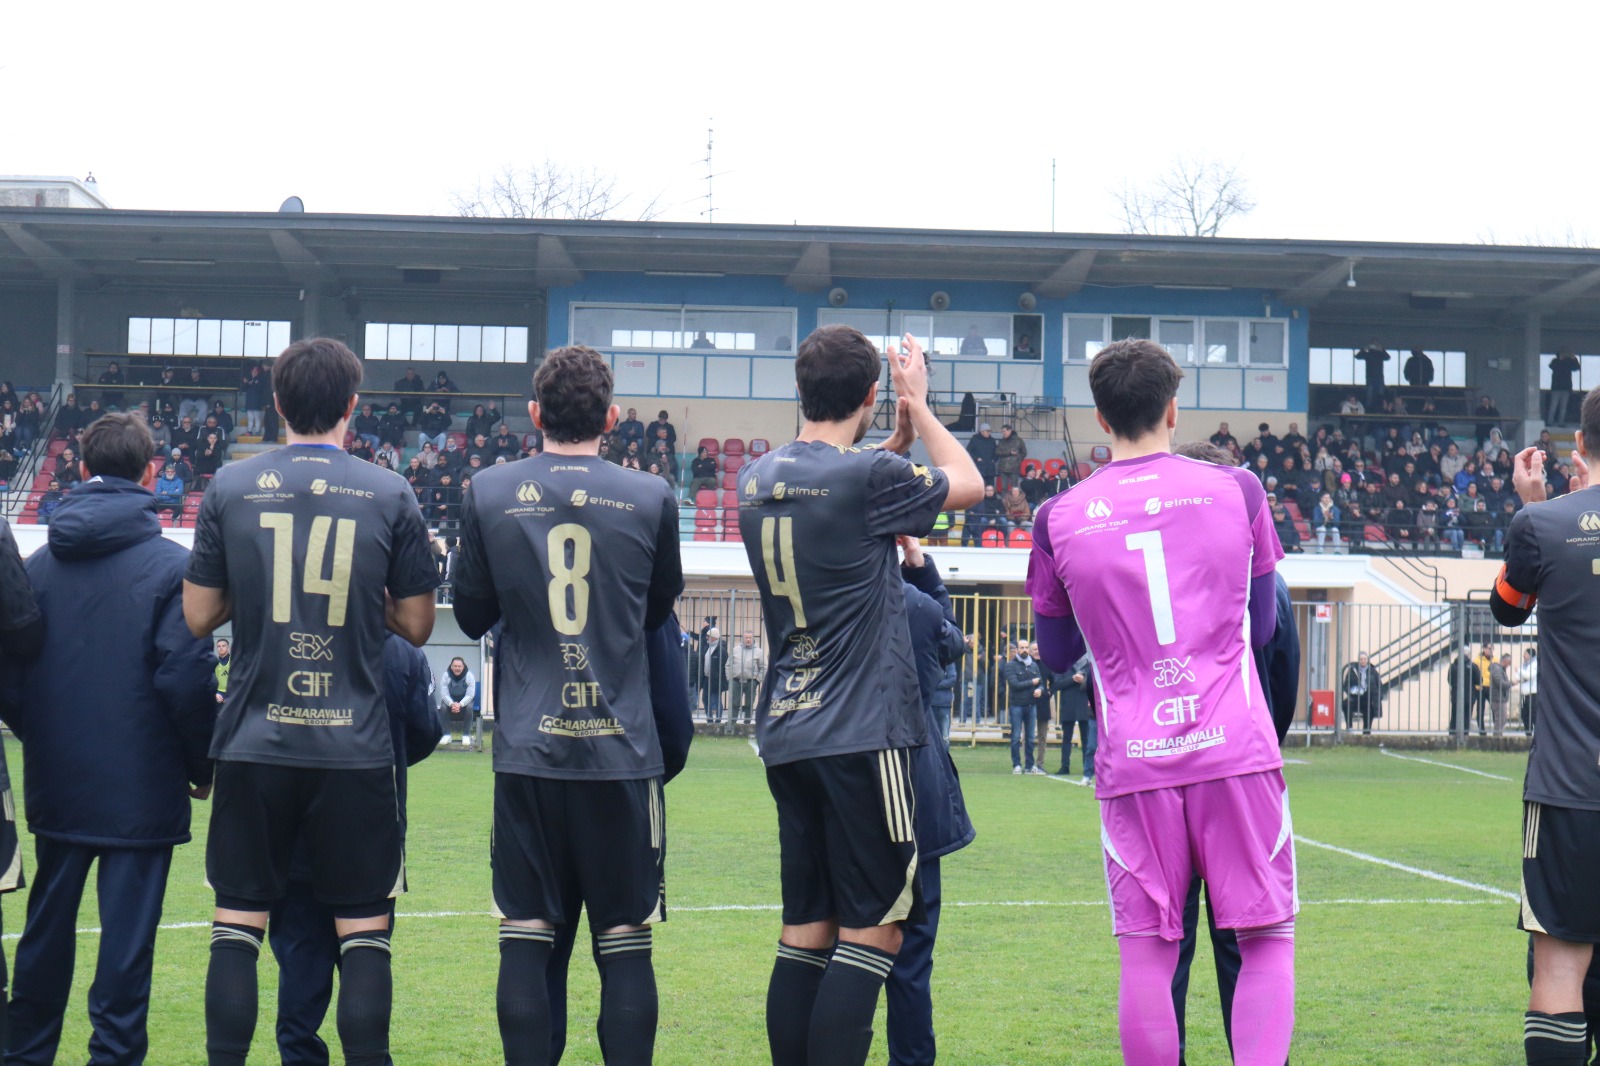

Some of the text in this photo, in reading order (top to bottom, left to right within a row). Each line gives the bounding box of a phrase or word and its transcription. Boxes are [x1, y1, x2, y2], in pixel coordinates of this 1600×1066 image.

[329, 485, 374, 498] elmec
[788, 486, 830, 496] elmec
[589, 497, 635, 511] elmec
[1164, 497, 1213, 508] elmec
[1075, 523, 1106, 535] MORANDI
[259, 512, 356, 626] 14
[761, 516, 807, 628] 4
[547, 523, 592, 635] 8
[1125, 530, 1176, 646] 1
[280, 706, 352, 718] CHIARAVALLI
[552, 718, 622, 730] CHIARAVALL
[1144, 726, 1224, 750] CHIARAVALLI
[1170, 744, 1200, 754] GROUP
